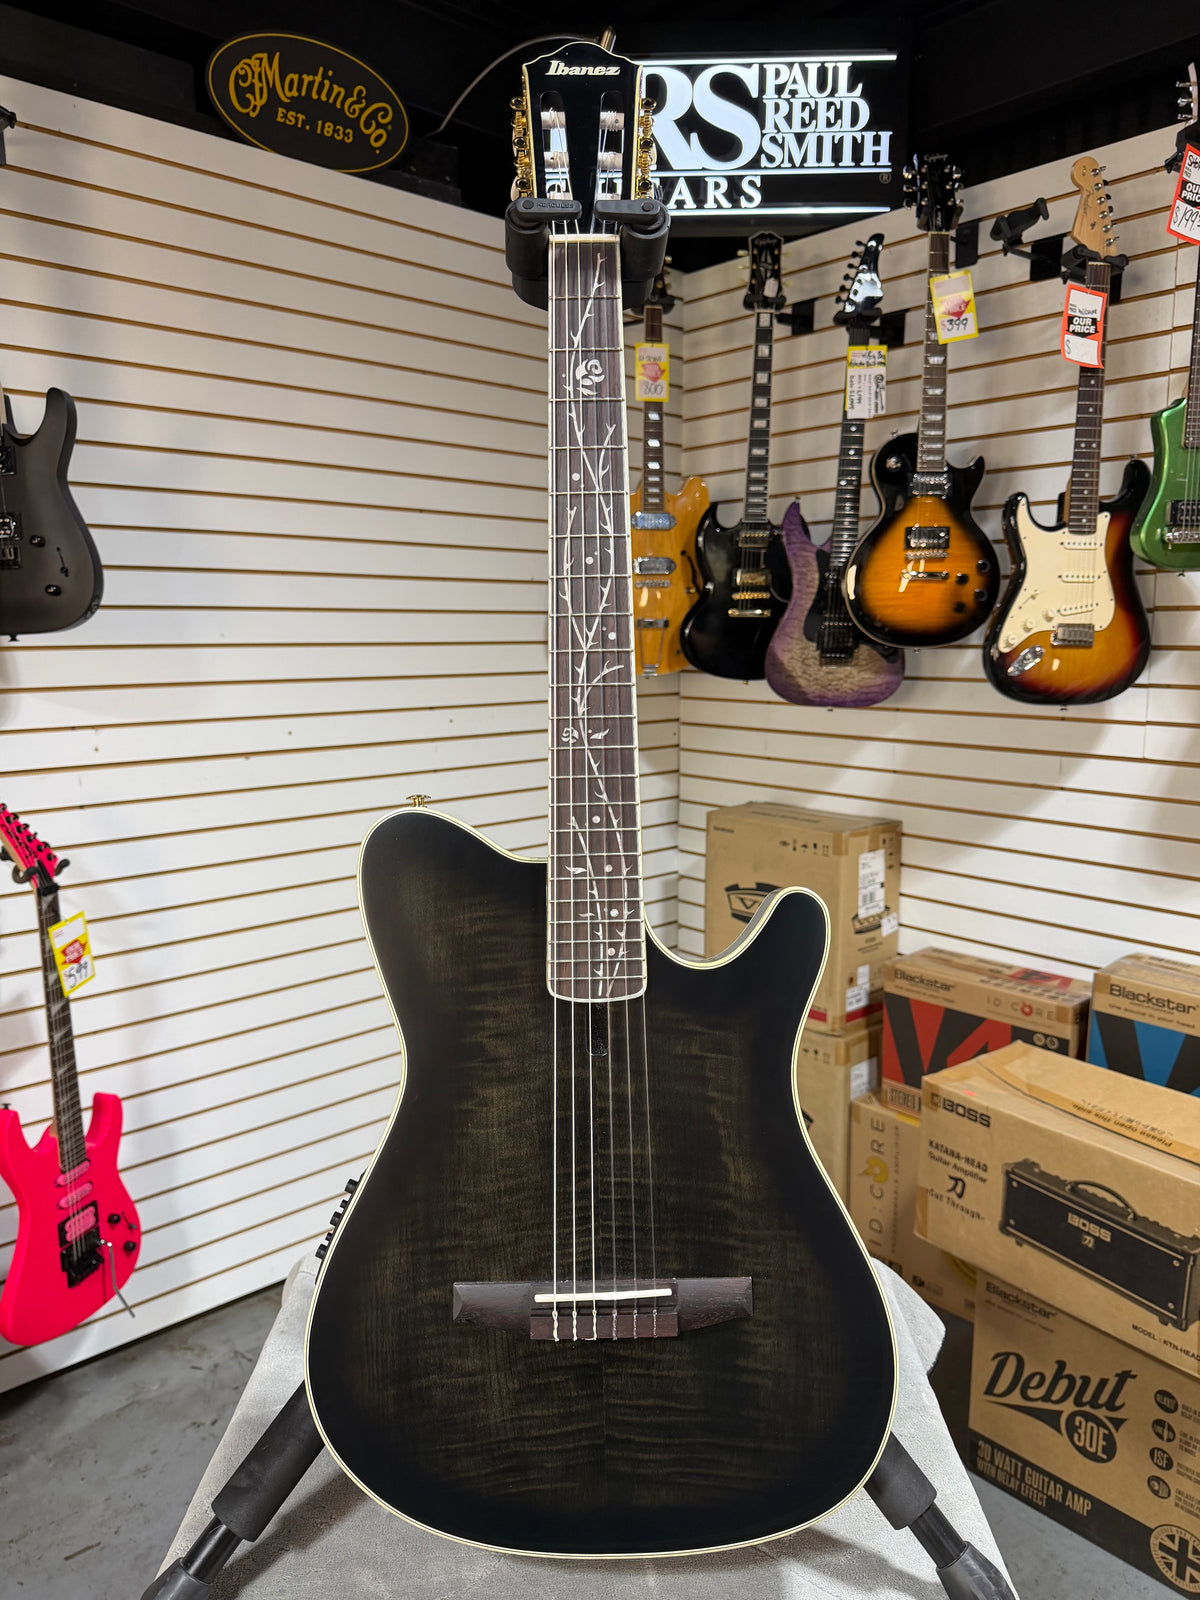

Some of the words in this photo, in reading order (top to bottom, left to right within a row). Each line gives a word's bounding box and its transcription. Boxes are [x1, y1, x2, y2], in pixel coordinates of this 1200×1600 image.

[545, 60, 621, 76] Ibanez
[763, 62, 862, 98] PAUL
[276, 107, 310, 131] EST.
[316, 120, 354, 143] 1833
[643, 64, 762, 171] RS
[763, 98, 870, 132] REED
[760, 131, 893, 168] SMITH
[1069, 325, 1096, 334] PRICE
[1073, 317, 1092, 326] OUR
[894, 969, 955, 993] Blackstar
[1109, 983, 1197, 1014] Blackstar
[942, 1097, 991, 1128] BOSS
[928, 1138, 988, 1173] KATANA-HEAD
[928, 1150, 951, 1167] Guitar
[952, 1162, 988, 1184] Amplifier
[946, 1174, 966, 1199] 刀
[1067, 1211, 1111, 1243] BOSS
[985, 1281, 1057, 1319] Blackstar
[1132, 1323, 1158, 1342] MODEL
[983, 1351, 1138, 1412] Debut
[1073, 1418, 1109, 1462] 30E
[1153, 1447, 1169, 1469] ISF
[977, 1440, 992, 1462] 30
[993, 1448, 1023, 1479] WATT
[1024, 1466, 1063, 1503] GUITAR
[1064, 1490, 1092, 1516] AMP
[997, 1468, 1020, 1492] DELAY
[1020, 1482, 1048, 1507] EFFECT
